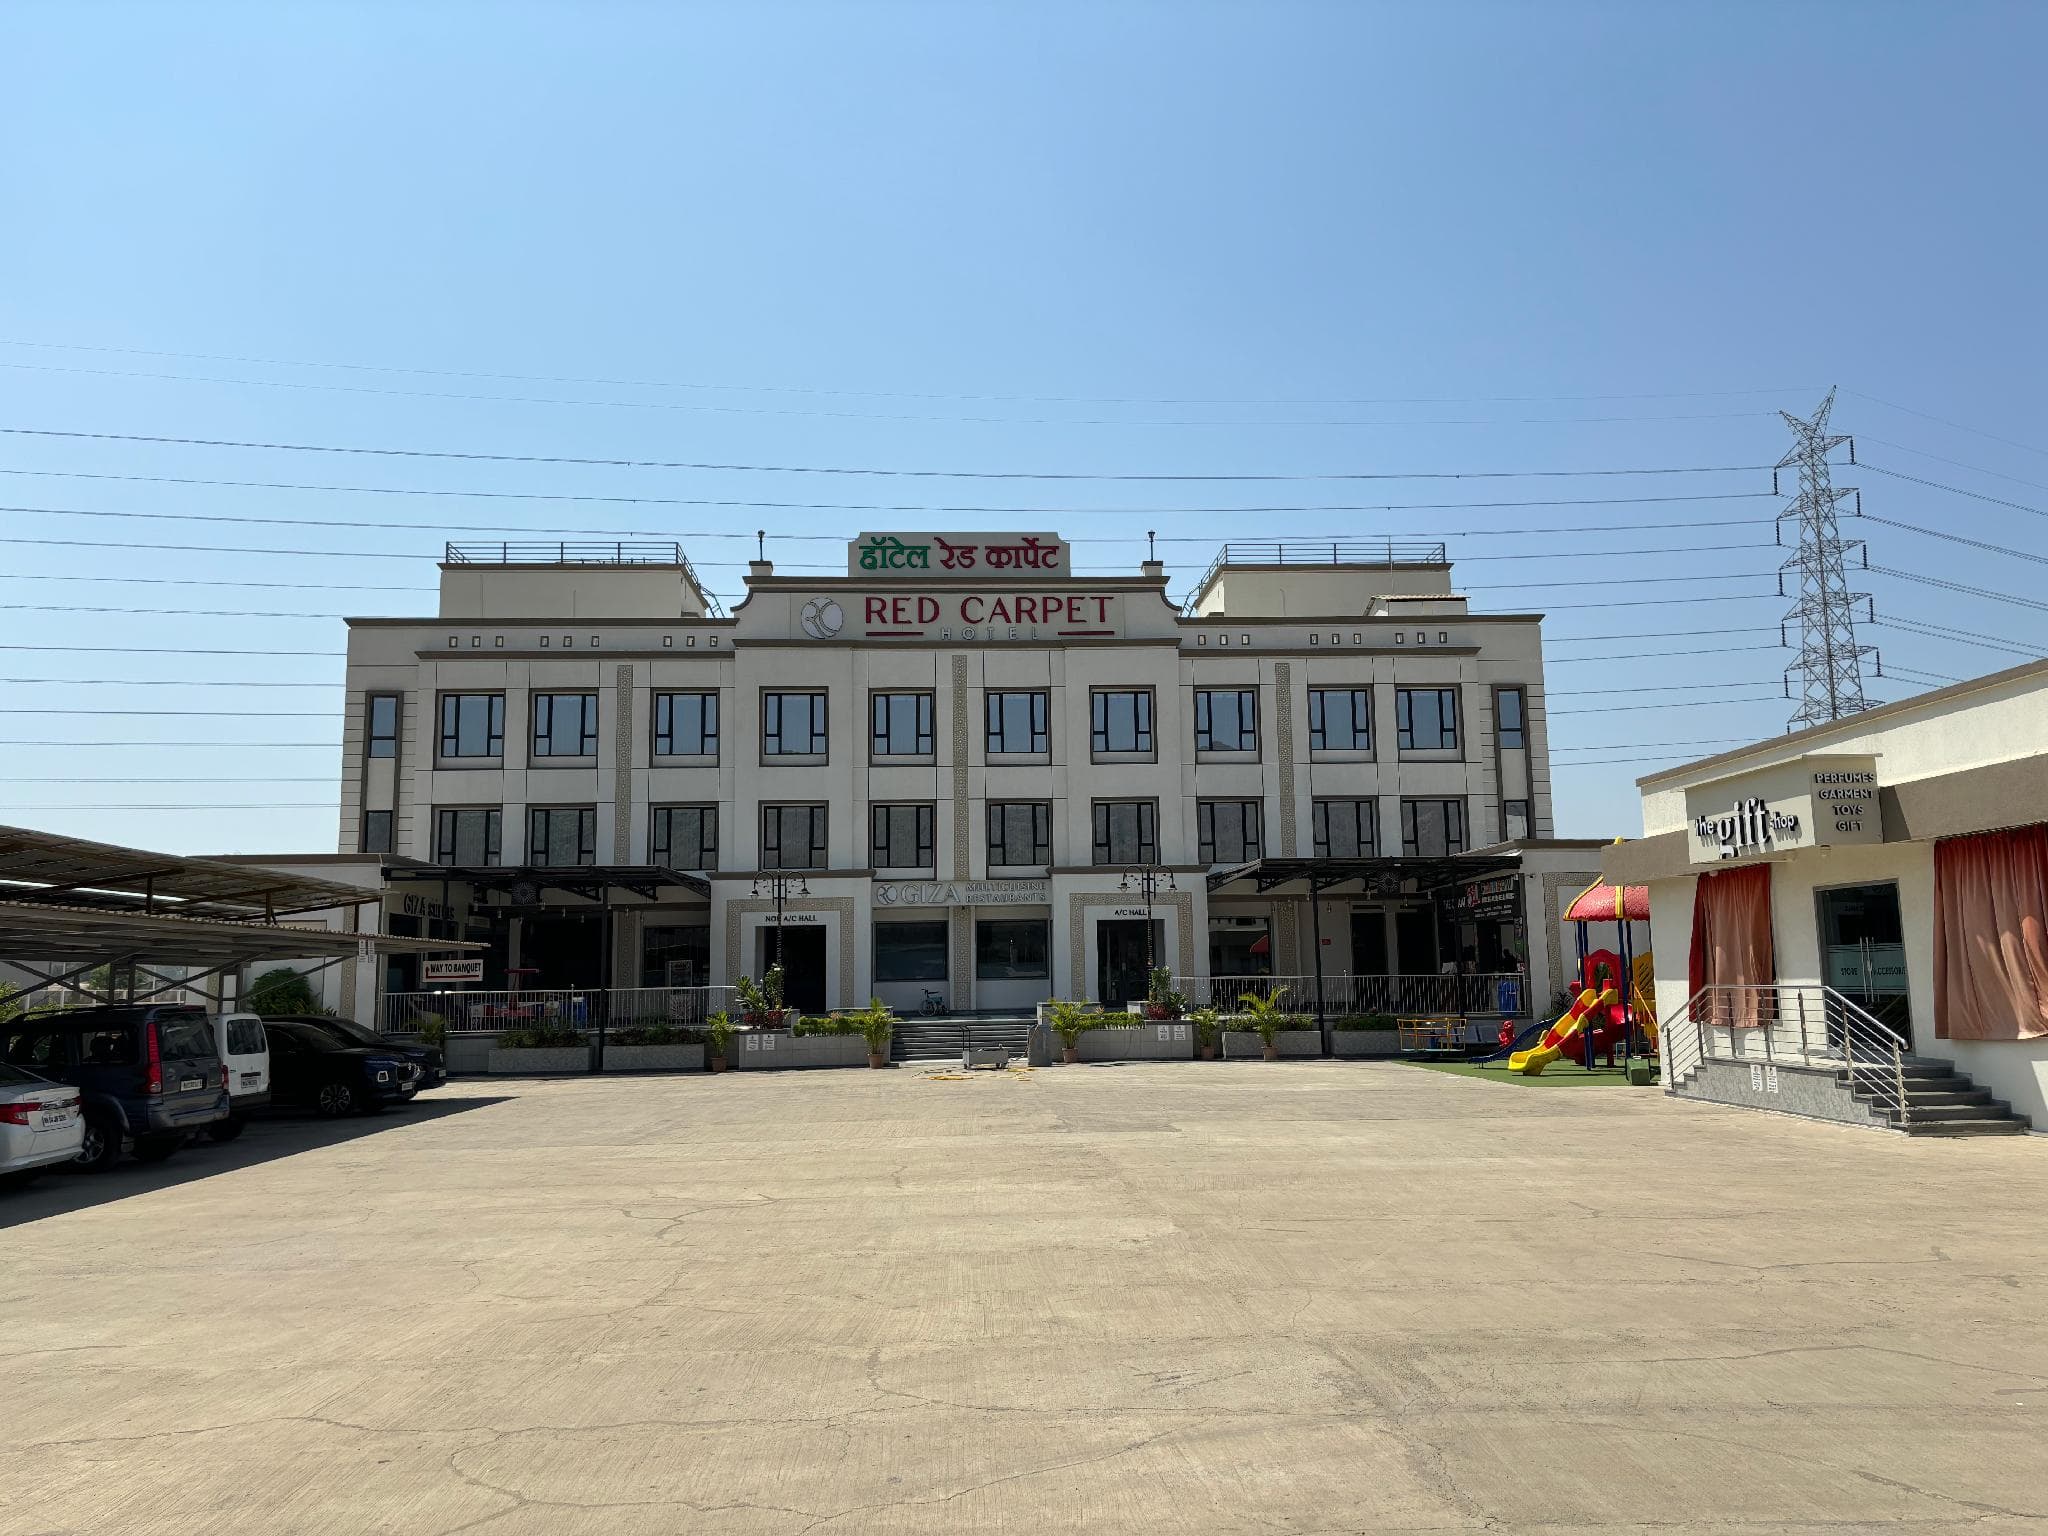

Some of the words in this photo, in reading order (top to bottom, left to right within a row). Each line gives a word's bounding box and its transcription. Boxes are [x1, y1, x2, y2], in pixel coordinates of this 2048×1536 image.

[858, 536, 931, 570] हॉटेल
[933, 536, 978, 569] रेड
[985, 537, 1060, 568] कार्पेट
[865, 597, 940, 624] RED
[960, 596, 1114, 624] CARPET
[940, 627, 1040, 641] HOTEL
[1815, 772, 1875, 783] PERFUMES
[1819, 788, 1873, 800] GARMENT
[1832, 805, 1864, 815] TOYS
[1696, 815, 1717, 837] the
[1717, 797, 1770, 859] gift
[1769, 811, 1799, 832] shop
[1836, 820, 1864, 831] GIFT
[900, 884, 960, 904] GIZA
[965, 881, 1046, 892] MULTICUISINE
[965, 892, 1047, 903] RESTAURANTS
[783, 914, 797, 922] A/C
[798, 914, 818, 922] HALL
[1128, 908, 1147, 916] HALL
[430, 963, 444, 973] WAY
[445, 963, 453, 973] TO
[453, 962, 482, 974] BANQUET
